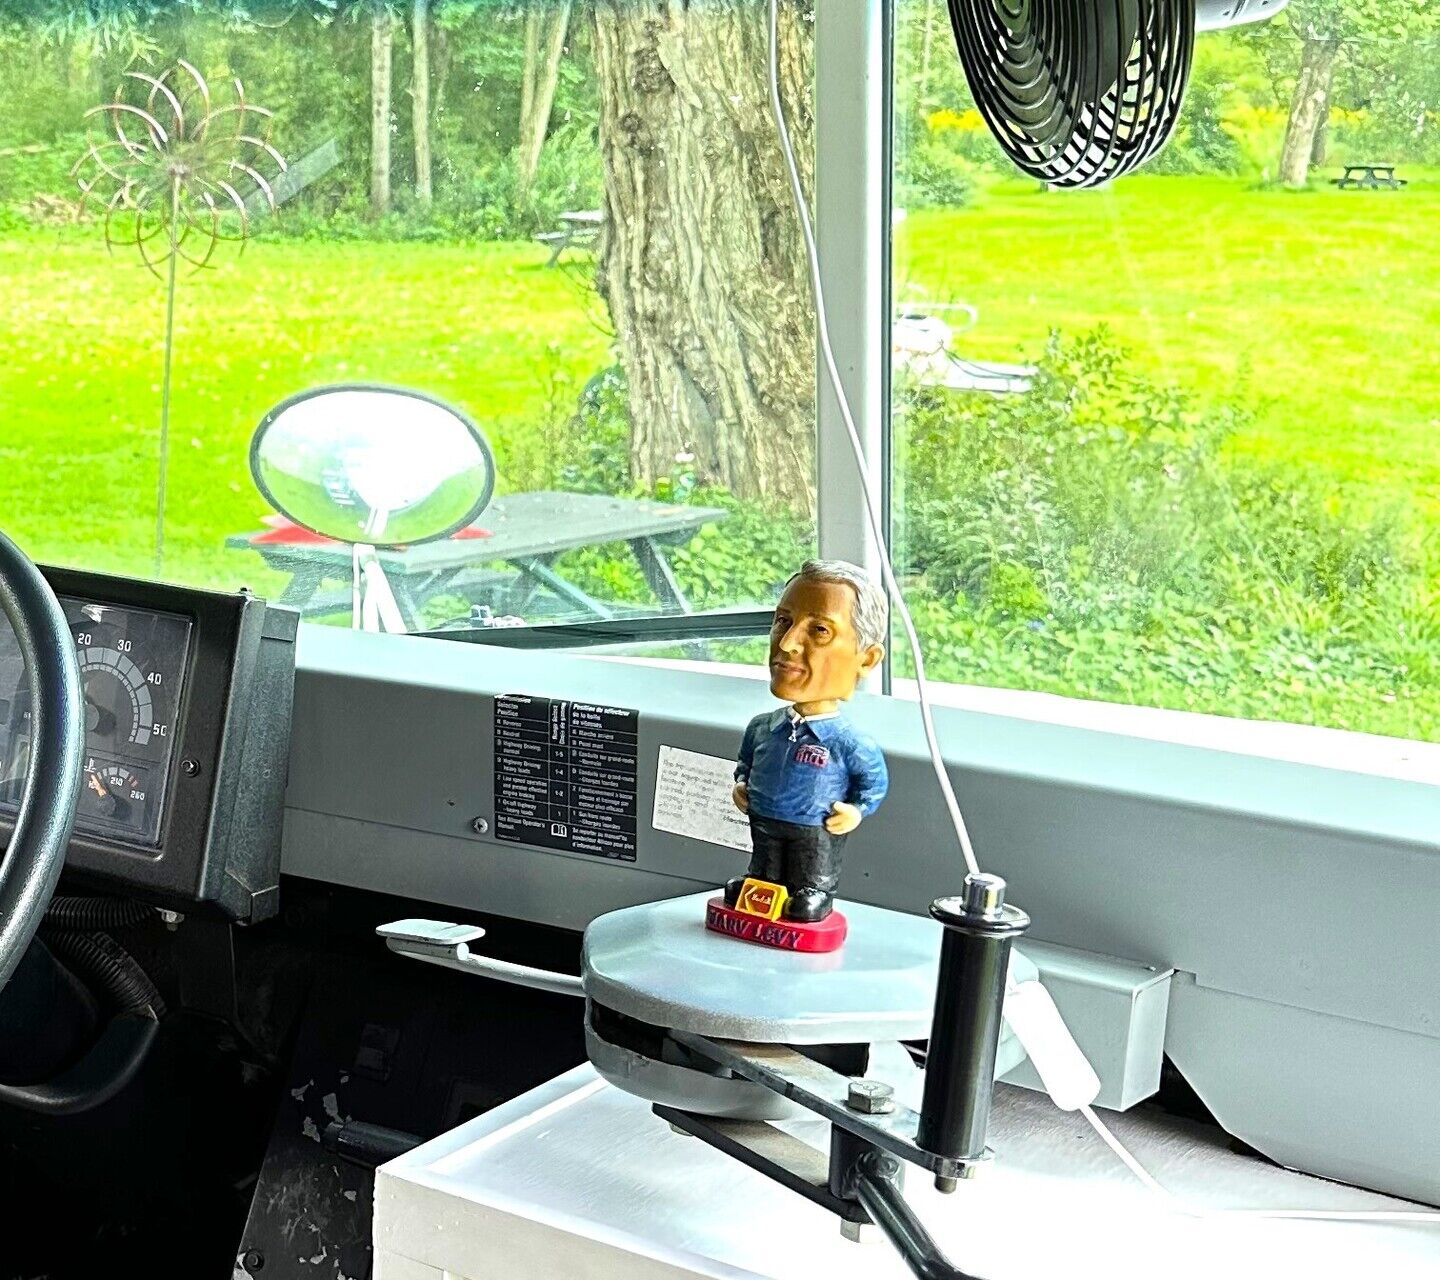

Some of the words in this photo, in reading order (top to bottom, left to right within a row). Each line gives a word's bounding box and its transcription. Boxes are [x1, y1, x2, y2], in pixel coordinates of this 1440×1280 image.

[78, 632, 92, 645] 20
[117, 640, 132, 652] 30
[147, 672, 162, 685] 40
[755, 923, 805, 950] LEVY
